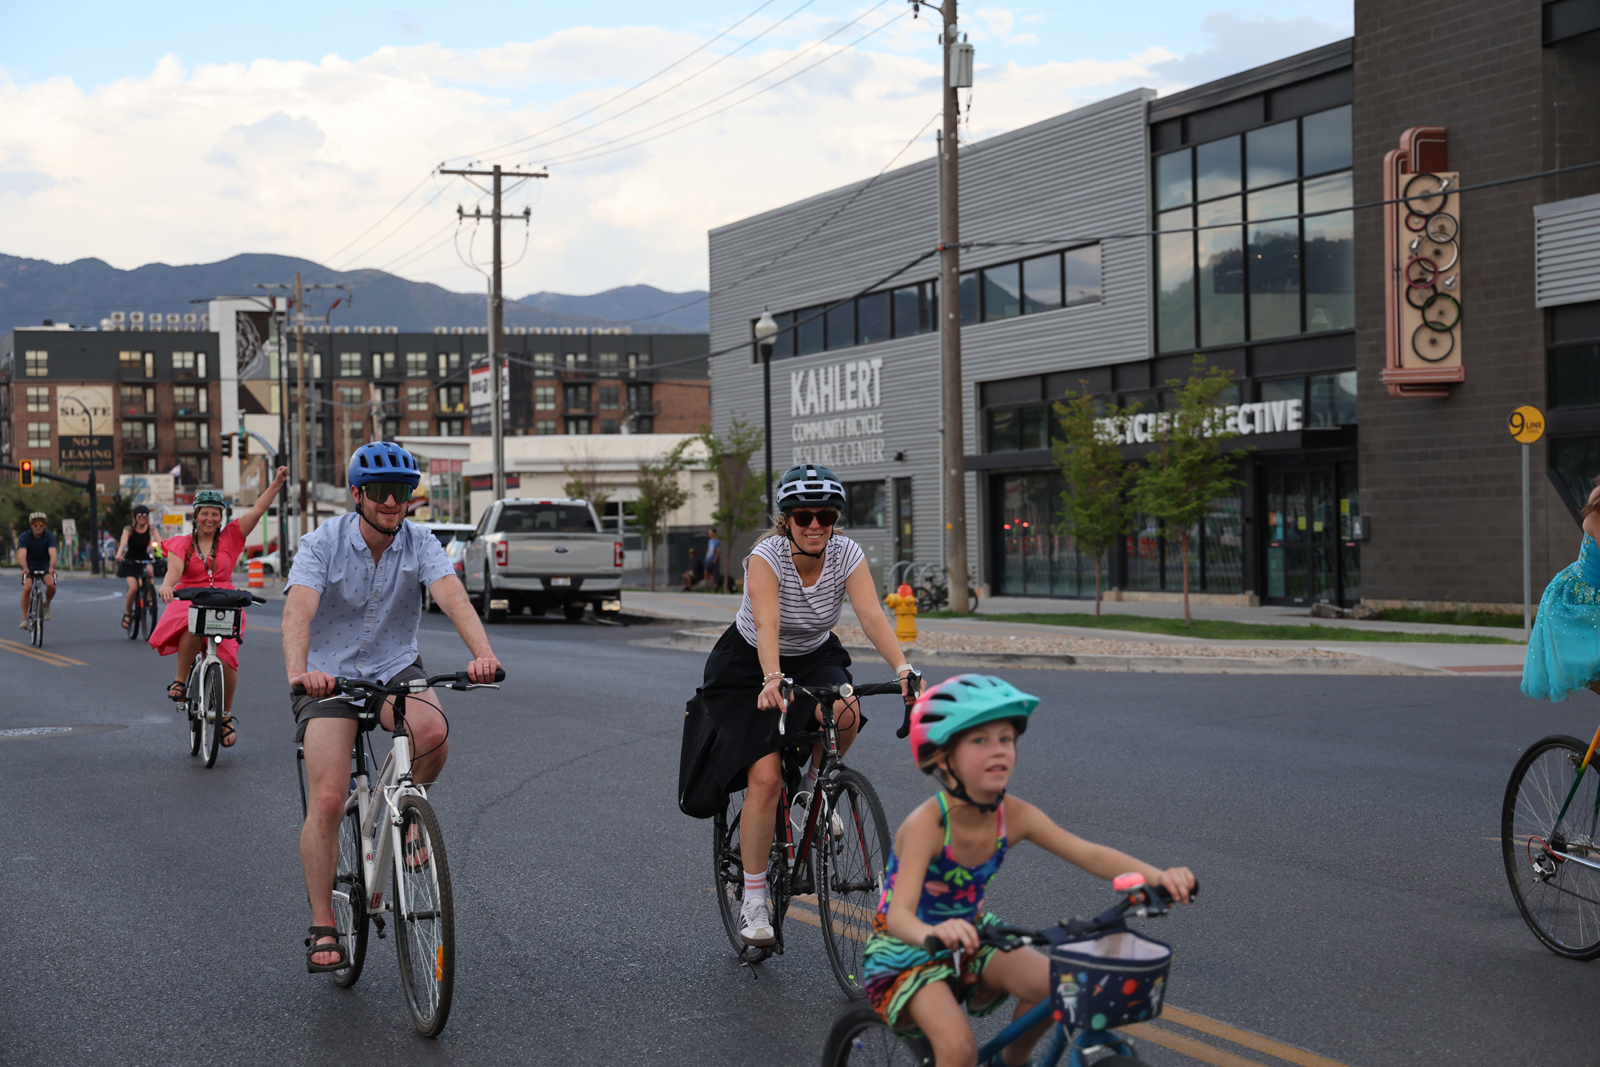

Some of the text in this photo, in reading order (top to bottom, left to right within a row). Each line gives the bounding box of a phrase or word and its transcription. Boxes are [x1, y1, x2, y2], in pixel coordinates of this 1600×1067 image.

[791, 358, 883, 417] KAHLERT
[792, 413, 884, 442] COMMUNITY BICYCLE
[1509, 412, 1542, 437] 9 LINE
[61, 449, 112, 460] LEASING
[844, 438, 885, 465] CENTER
